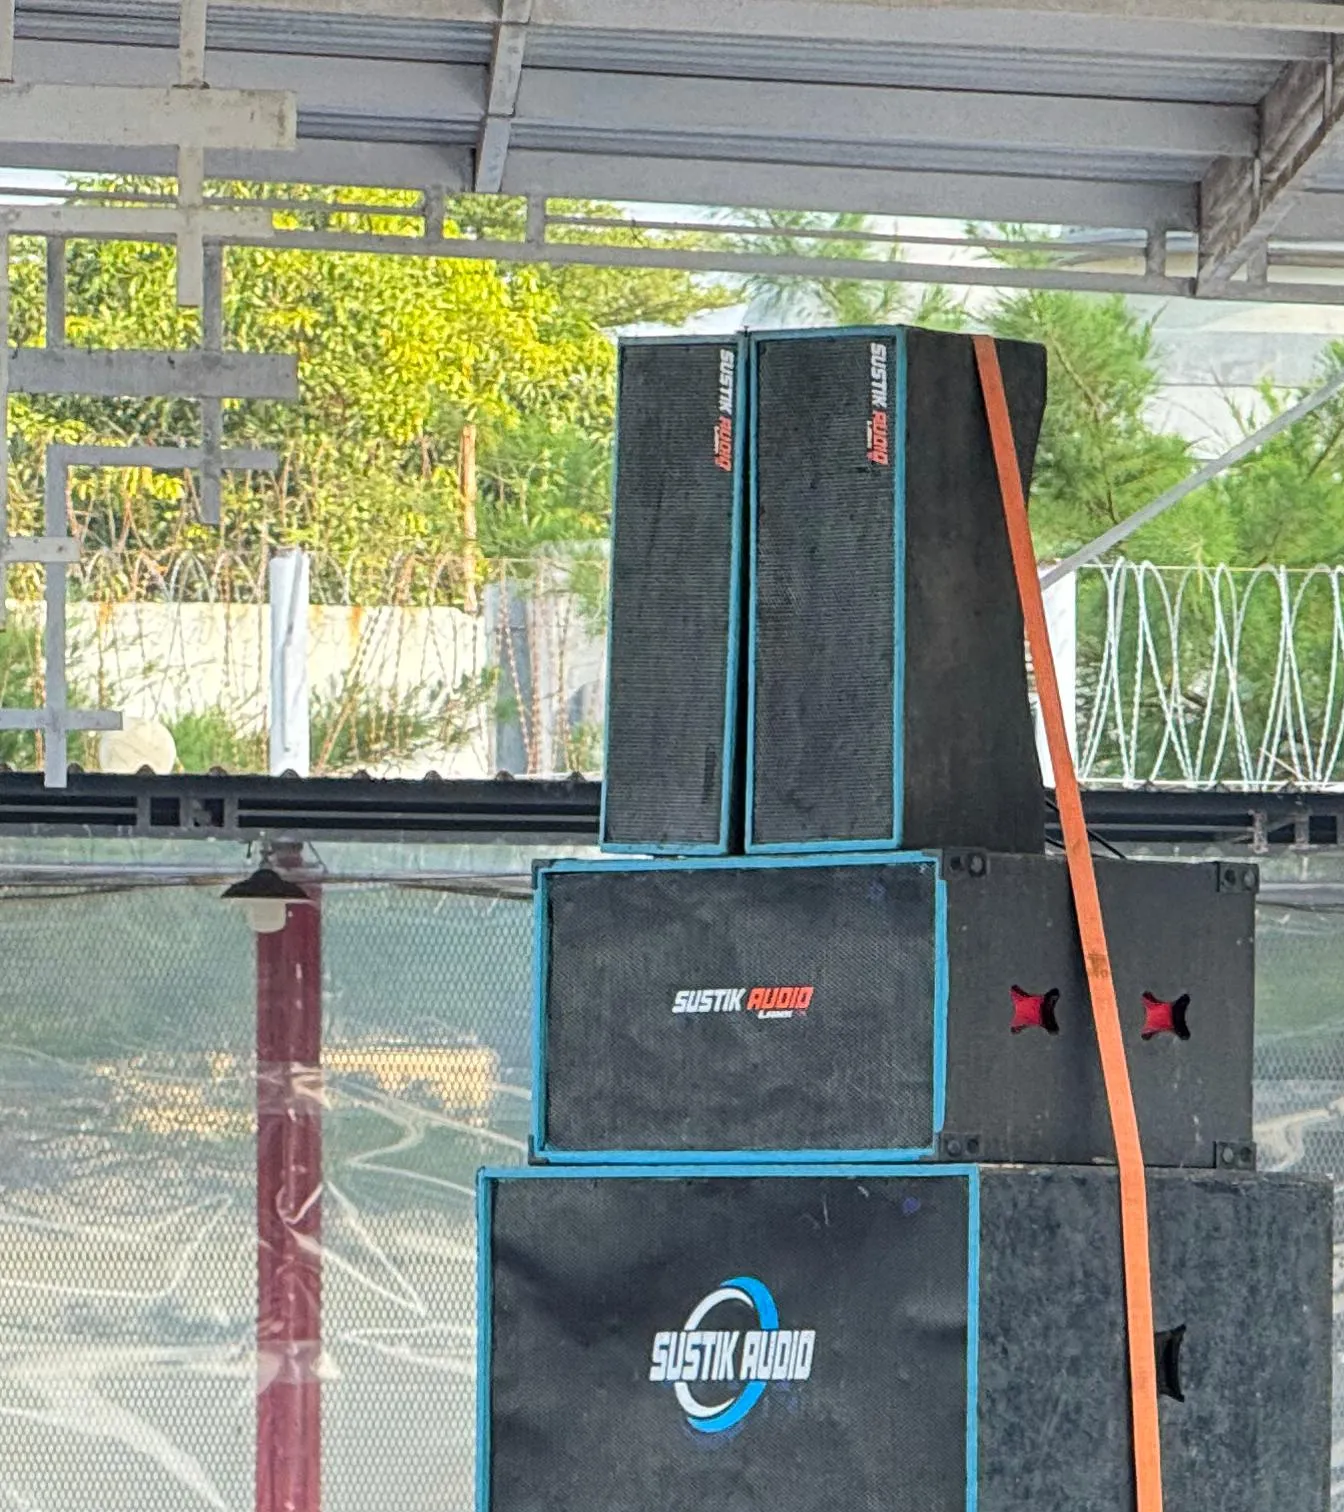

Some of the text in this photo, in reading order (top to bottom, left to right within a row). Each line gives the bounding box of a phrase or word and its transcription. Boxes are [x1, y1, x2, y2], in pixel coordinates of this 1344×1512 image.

[718, 349, 735, 472] SUSTIK AUDIO
[870, 343, 889, 465] SUSTIK AUDIO
[672, 987, 814, 1013] SUSTIK AUDIO
[650, 1330, 816, 1381] SUSTIK AUDIO
